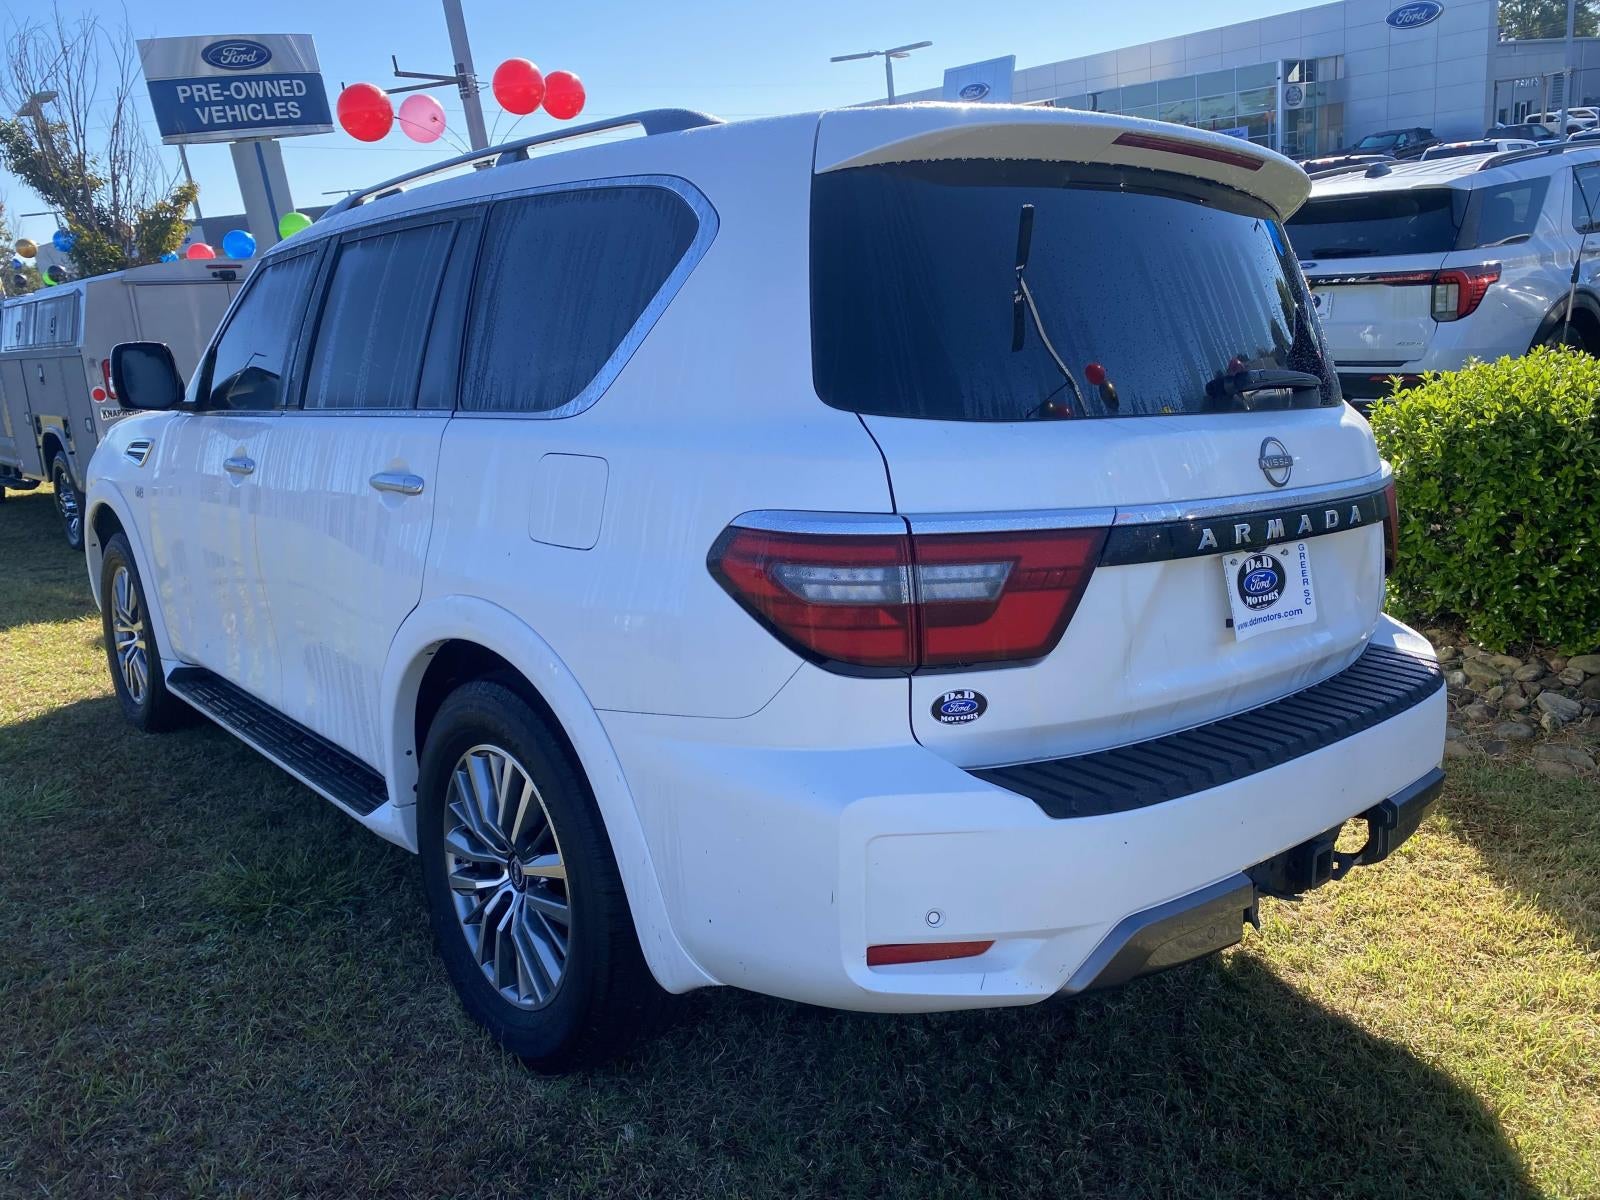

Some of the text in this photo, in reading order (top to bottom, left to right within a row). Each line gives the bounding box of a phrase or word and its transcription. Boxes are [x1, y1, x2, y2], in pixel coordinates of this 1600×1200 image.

[1395, 7, 1428, 24] Ford
[220, 46, 257, 64] Ford
[176, 79, 307, 104] PRE-OWNED
[194, 101, 302, 125] VEHICLES
[1197, 505, 1362, 551] ARMADA
[1245, 556, 1273, 574] D&D
[1250, 573, 1271, 591] Ford
[1298, 543, 1312, 606] GREER SC
[1245, 589, 1279, 606] MOTORS
[1237, 608, 1303, 630] www.ddmotors.com
[944, 690, 976, 702] D&D
[948, 702, 971, 713] Ford
[940, 712, 979, 722] MOTORS
